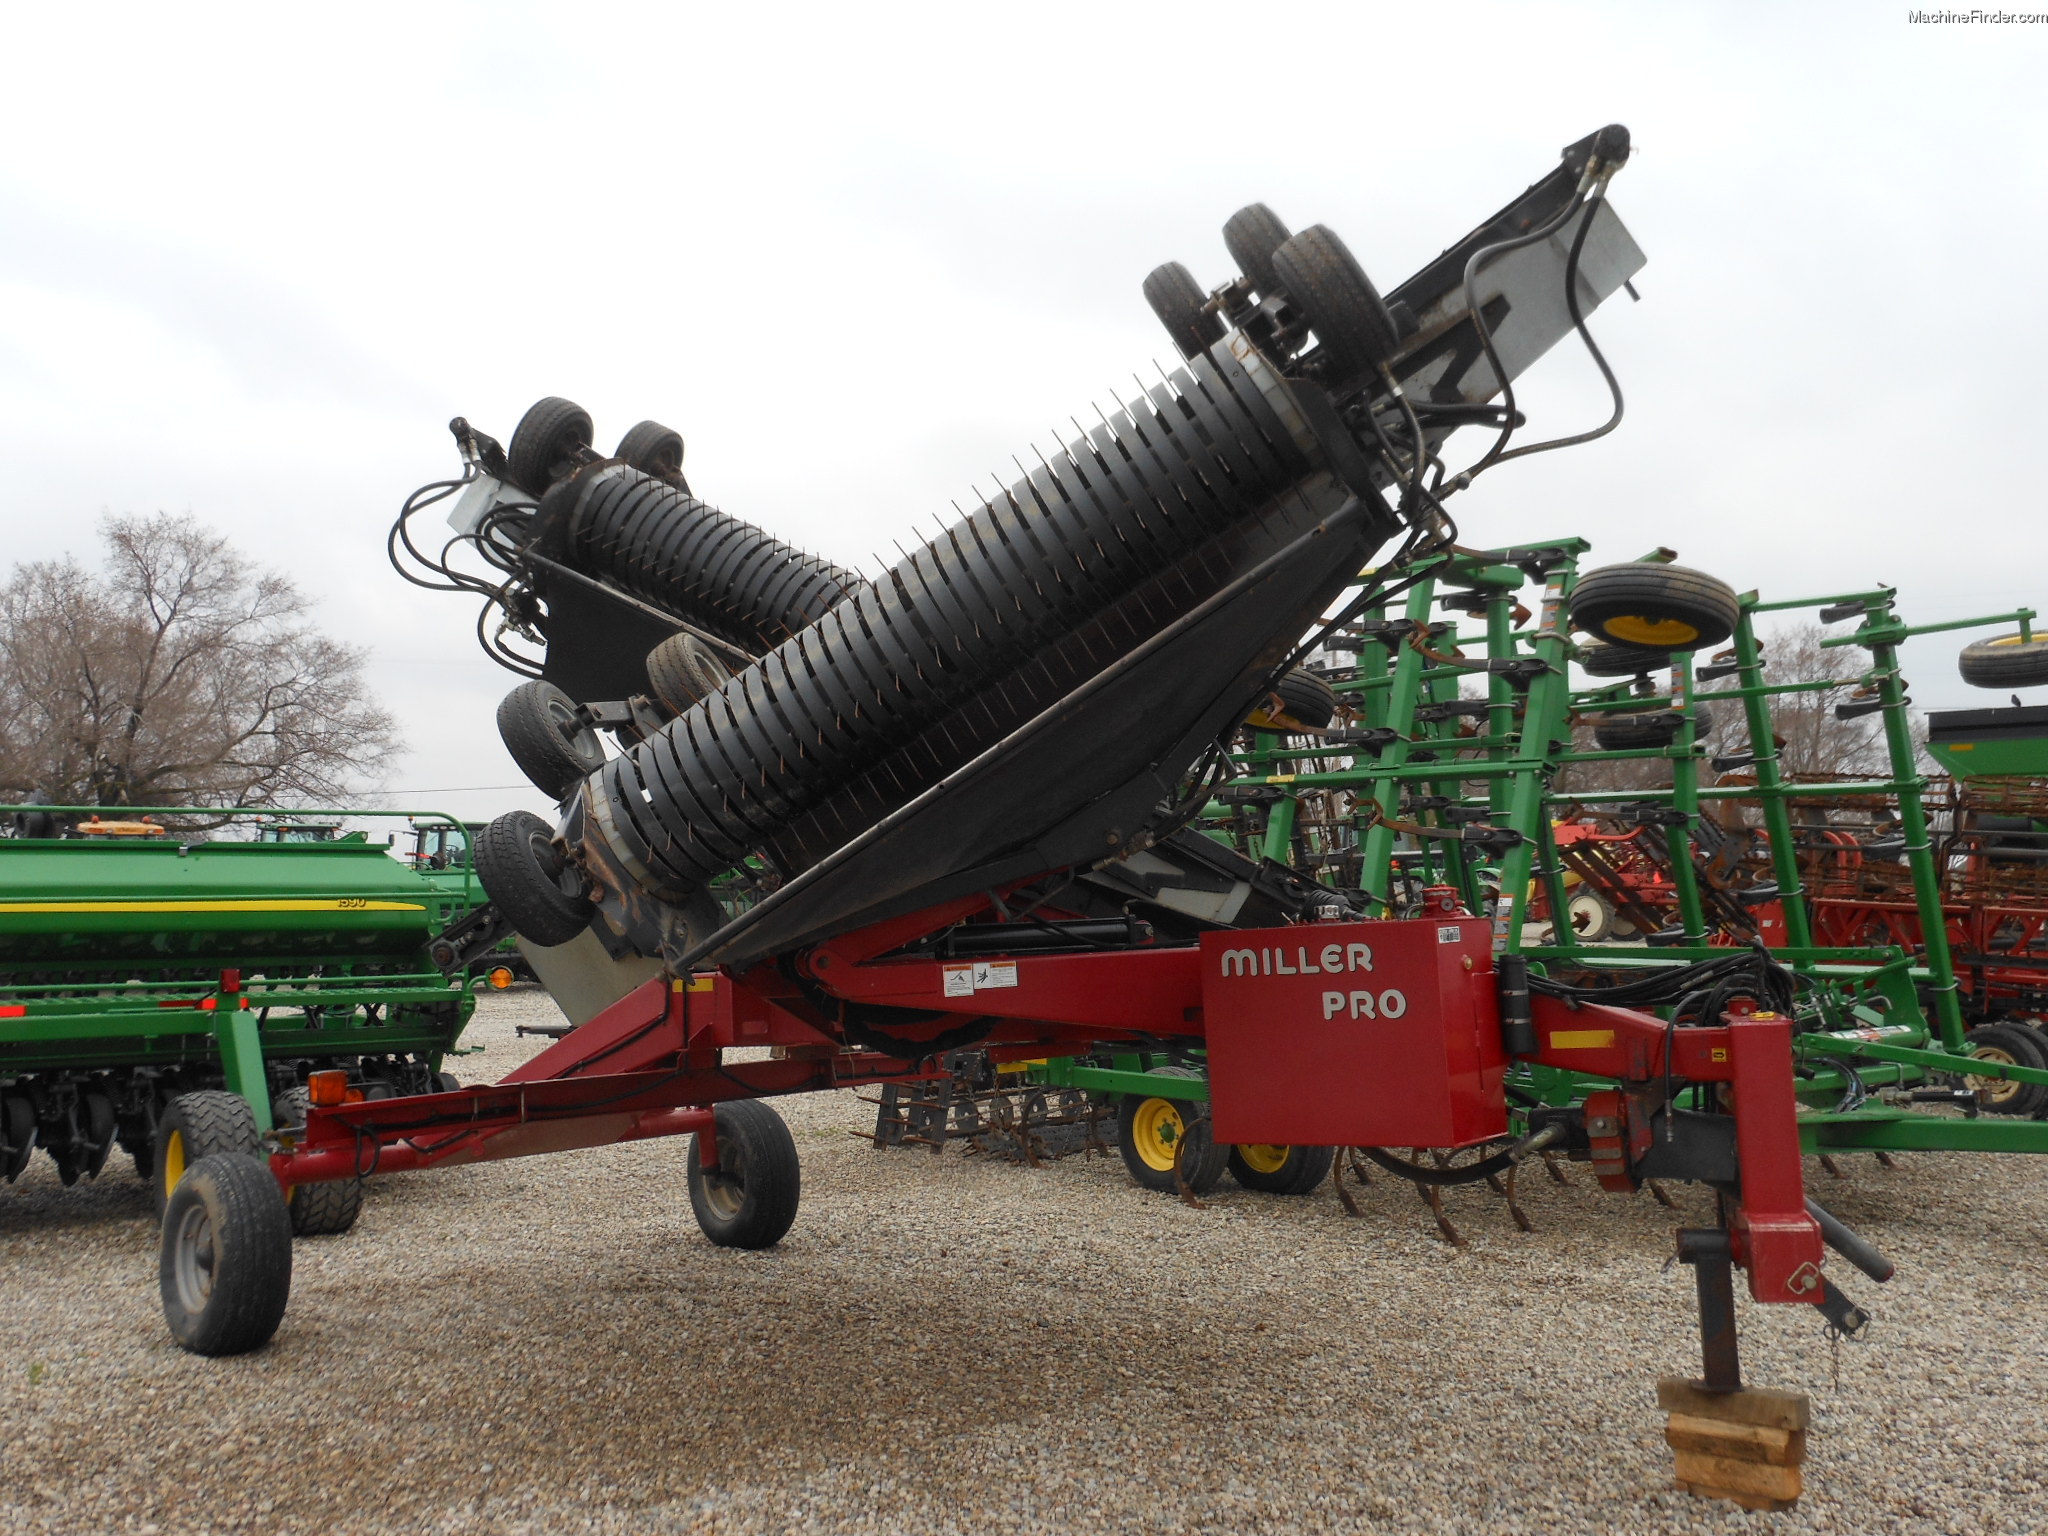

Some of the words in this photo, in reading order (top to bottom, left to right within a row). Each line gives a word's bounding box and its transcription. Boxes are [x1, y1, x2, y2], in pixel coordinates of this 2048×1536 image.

[337, 898, 366, 907] 1590
[1221, 943, 1373, 977] MILLER
[1322, 988, 1407, 1020] PRO
